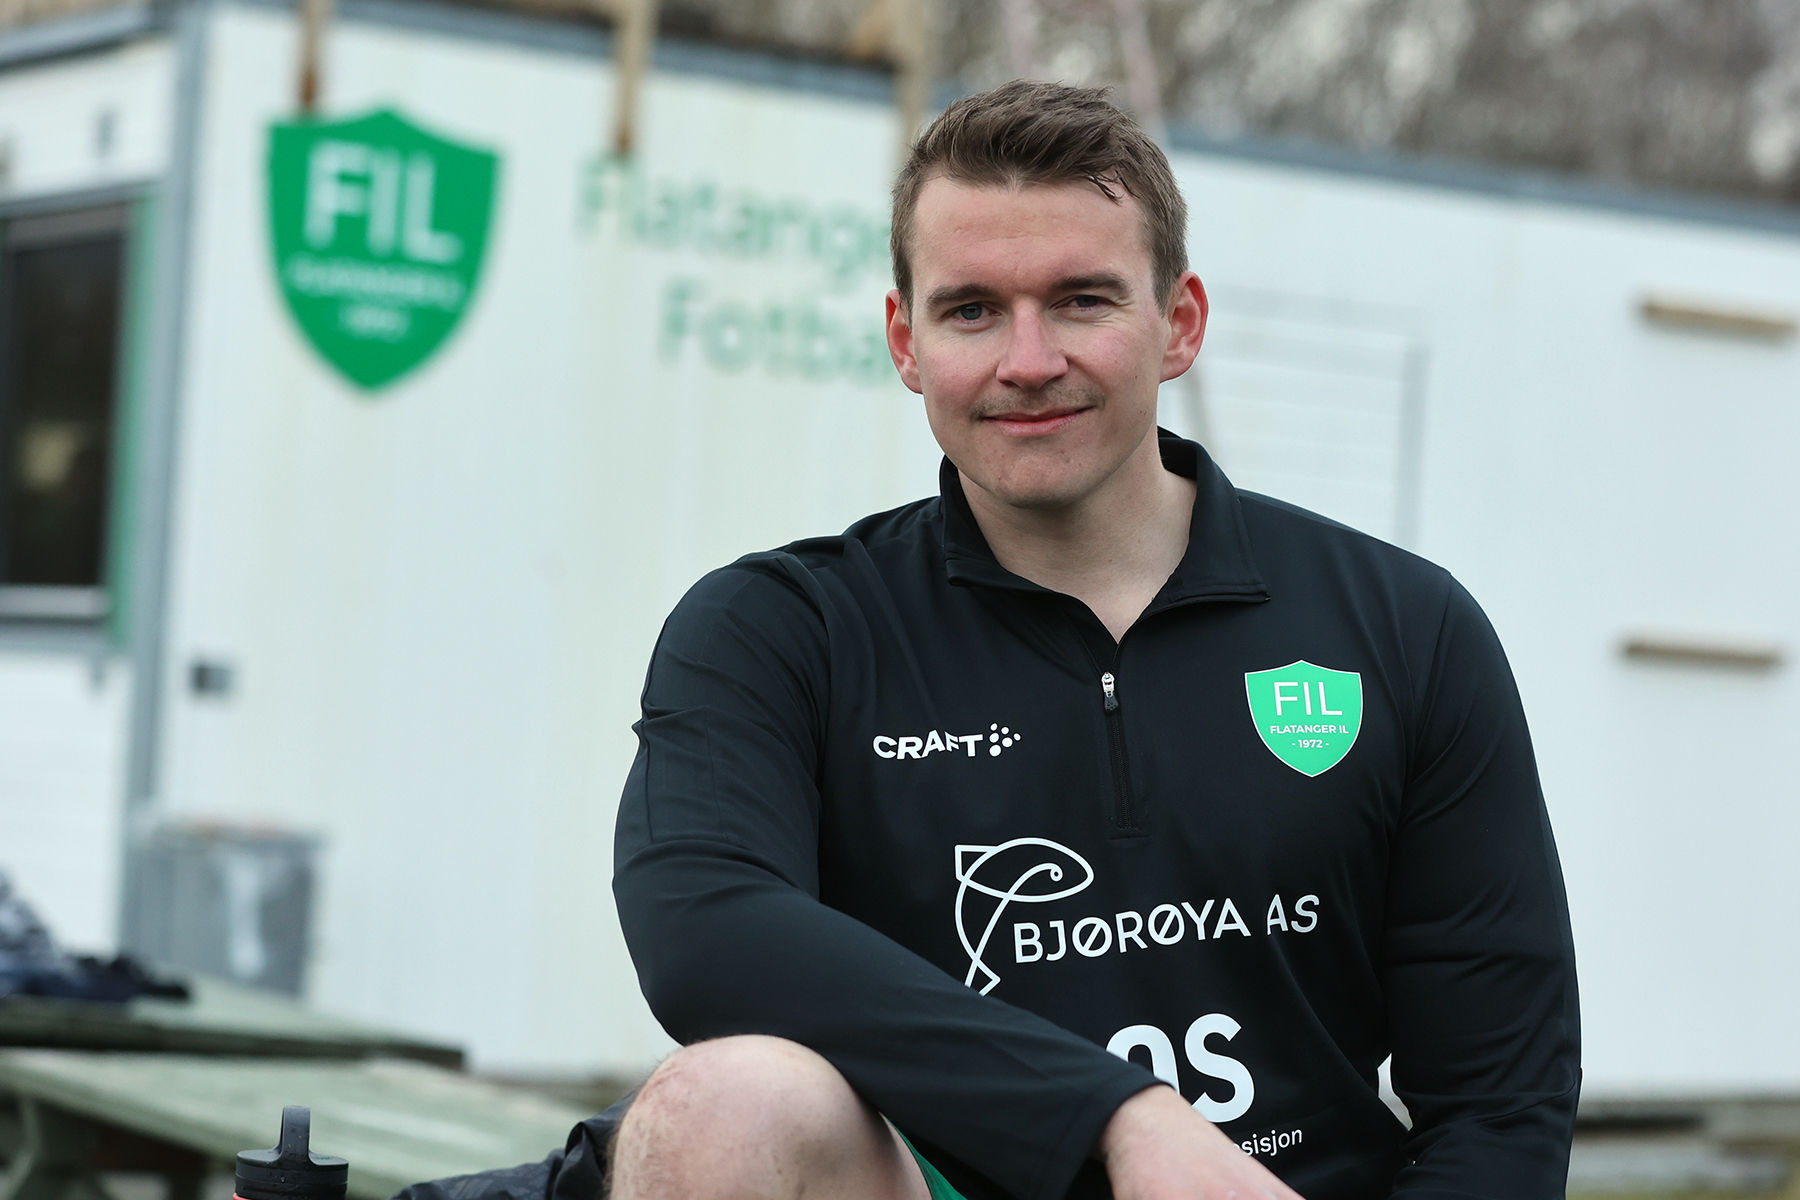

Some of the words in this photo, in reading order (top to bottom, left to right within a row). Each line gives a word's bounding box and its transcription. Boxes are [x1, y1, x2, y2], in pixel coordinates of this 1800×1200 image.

[305, 141, 462, 264] FIL
[658, 277, 897, 387] Fotba
[1273, 681, 1343, 716] FIL
[872, 729, 984, 760] CRAFT
[1269, 724, 1337, 735] FLATANGER
[1339, 724, 1349, 734] IL
[1297, 739, 1324, 748] 1972
[1013, 897, 1251, 964] BJØRØYA
[1266, 894, 1320, 935] AS
